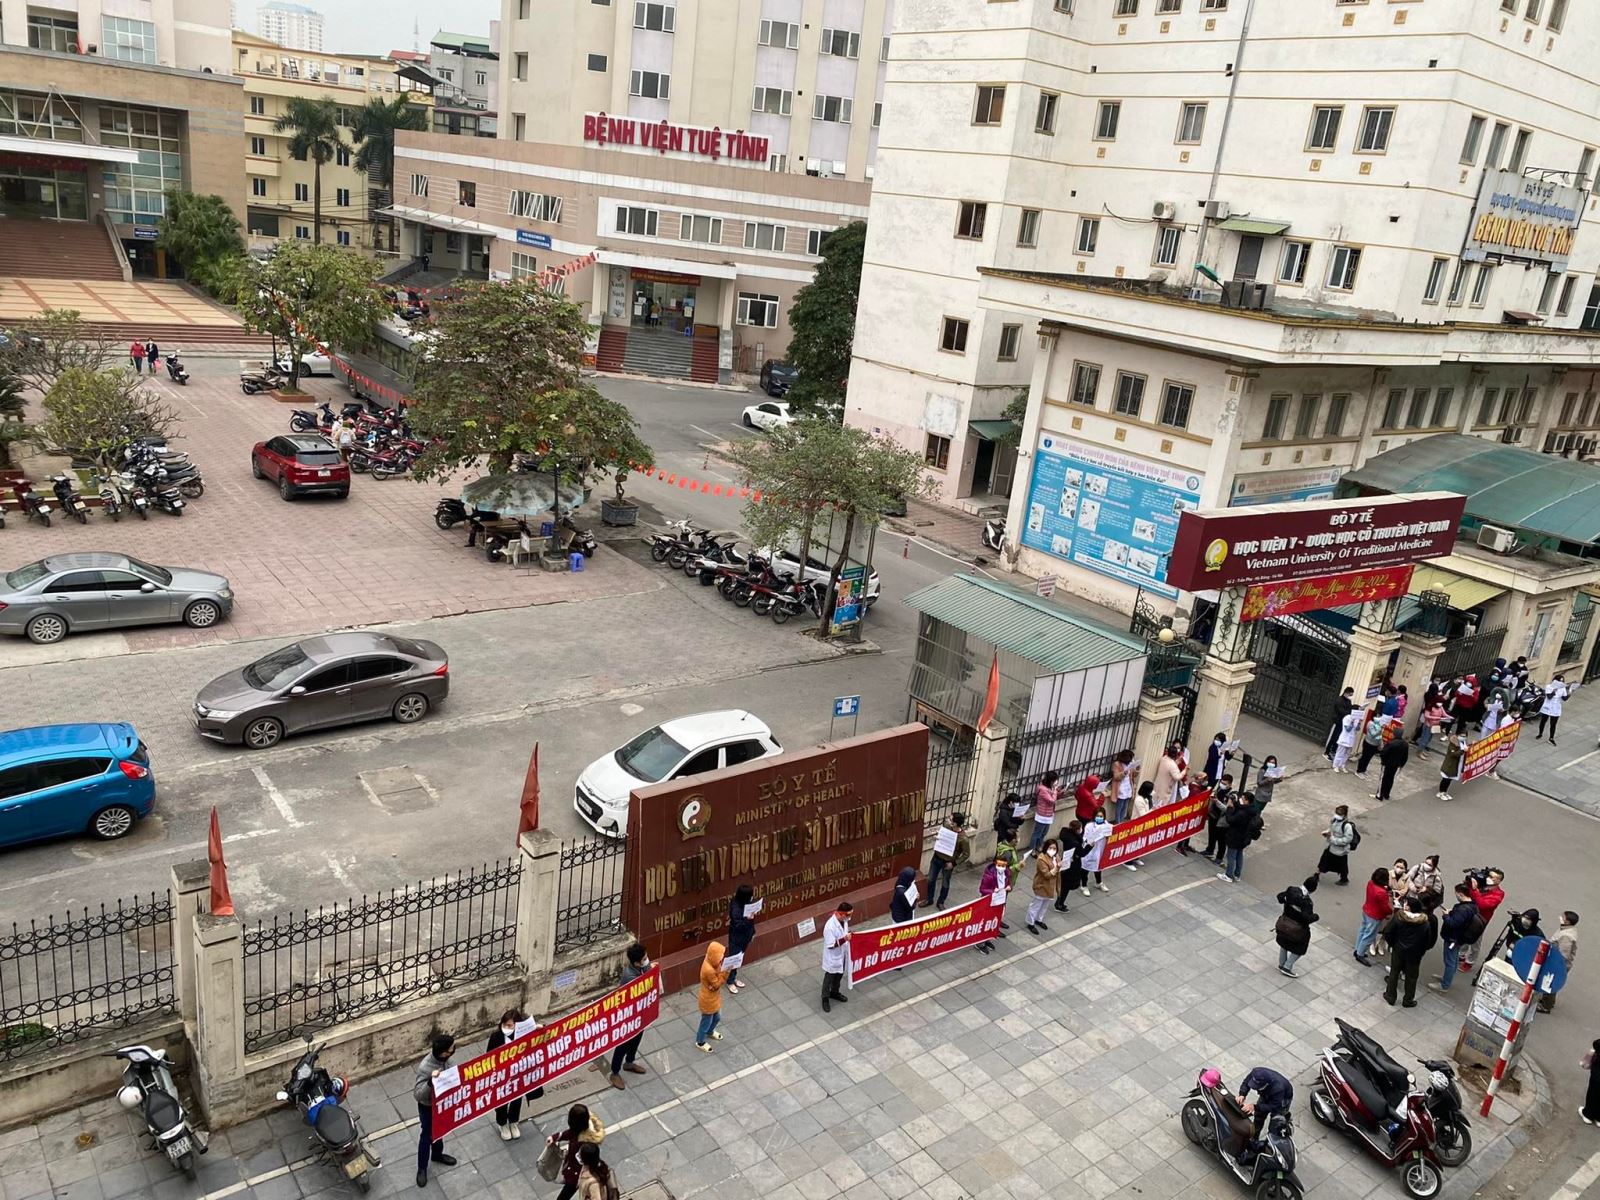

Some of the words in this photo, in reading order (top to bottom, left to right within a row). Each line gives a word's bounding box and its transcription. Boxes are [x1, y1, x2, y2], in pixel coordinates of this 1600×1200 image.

[584, 111, 635, 146] BỆNH
[640, 119, 684, 154] VIỆN
[688, 126, 722, 161] TUỆ
[726, 129, 769, 162] TĨNH
[1473, 212, 1508, 249] BỆNH
[1504, 218, 1534, 254] VIỆN
[1233, 540, 1259, 556] HỌC
[1260, 536, 1288, 553] VIỆN
[1289, 536, 1298, 549] Y
[1305, 532, 1335, 548] DƯỢC
[1335, 531, 1357, 545] HỌC
[1358, 524, 1374, 541] CỔ
[1372, 521, 1409, 539] TRUYỀN
[1409, 521, 1429, 536] VIỆT
[1428, 520, 1450, 533] NAM
[1329, 511, 1348, 528] BỘ
[1349, 513, 1358, 524] Y
[1359, 508, 1375, 522] TẾ
[1246, 557, 1288, 569] Vietnam
[1290, 550, 1337, 564] University
[1338, 547, 1352, 558] Of
[1353, 541, 1398, 556] Traditional
[1397, 538, 1433, 550] Medicine
[792, 773, 806, 791] Y
[812, 758, 837, 786] TẾ
[735, 799, 793, 826] MINISTRY
[795, 795, 811, 808] OF
[812, 782, 855, 804] HEALTH
[645, 862, 677, 906] HỌC
[717, 846, 728, 881] Y
[731, 831, 769, 877] DƯỢC
[901, 789, 926, 824] NAM
[1109, 844, 1124, 860] THÌ
[1125, 836, 1147, 855] NHÂN
[1148, 830, 1166, 845] VIÊN
[1166, 826, 1176, 840] BỊ
[1177, 818, 1188, 834] BỎ
[801, 886, 816, 901] HÀ
[819, 877, 850, 896] ĐÔNG
[856, 868, 871, 883] HÀ
[879, 930, 895, 947] ĐỀ
[895, 927, 921, 943] NGHỊ
[922, 915, 951, 934] CHÍNH
[952, 906, 973, 925] PHỦ
[880, 944, 904, 962] VIỆC
[906, 943, 912, 955] 1
[913, 938, 929, 955] CƠ
[930, 933, 954, 951] QUAN
[955, 930, 962, 941] 2
[964, 918, 984, 938] CHẾ
[985, 916, 999, 932] ĐỘ
[463, 1055, 497, 1082] NGHỊ
[499, 1042, 529, 1066] HỌC
[531, 1028, 558, 1047] VIỆN
[562, 1006, 600, 1033] YDHCT
[603, 989, 628, 1013] VIỆT
[630, 974, 655, 998] NAM
[435, 1085, 472, 1114] THỰC
[475, 1068, 506, 1093] HIỆN
[509, 1052, 545, 1076] ĐÚNG
[546, 1033, 572, 1061] HỢP
[575, 1016, 609, 1045] ĐỒNG
[610, 1004, 634, 1026] LÀM
[636, 988, 658, 1012] VIỆC
[454, 1102, 472, 1123] ĐÃ
[475, 1091, 492, 1112] KÝ
[496, 1076, 519, 1101] KẾT
[523, 1065, 545, 1087] VỚI
[548, 1047, 586, 1075] NGƯỜI
[588, 1037, 610, 1055] LAO
[611, 1015, 642, 1042] ĐỘNG
